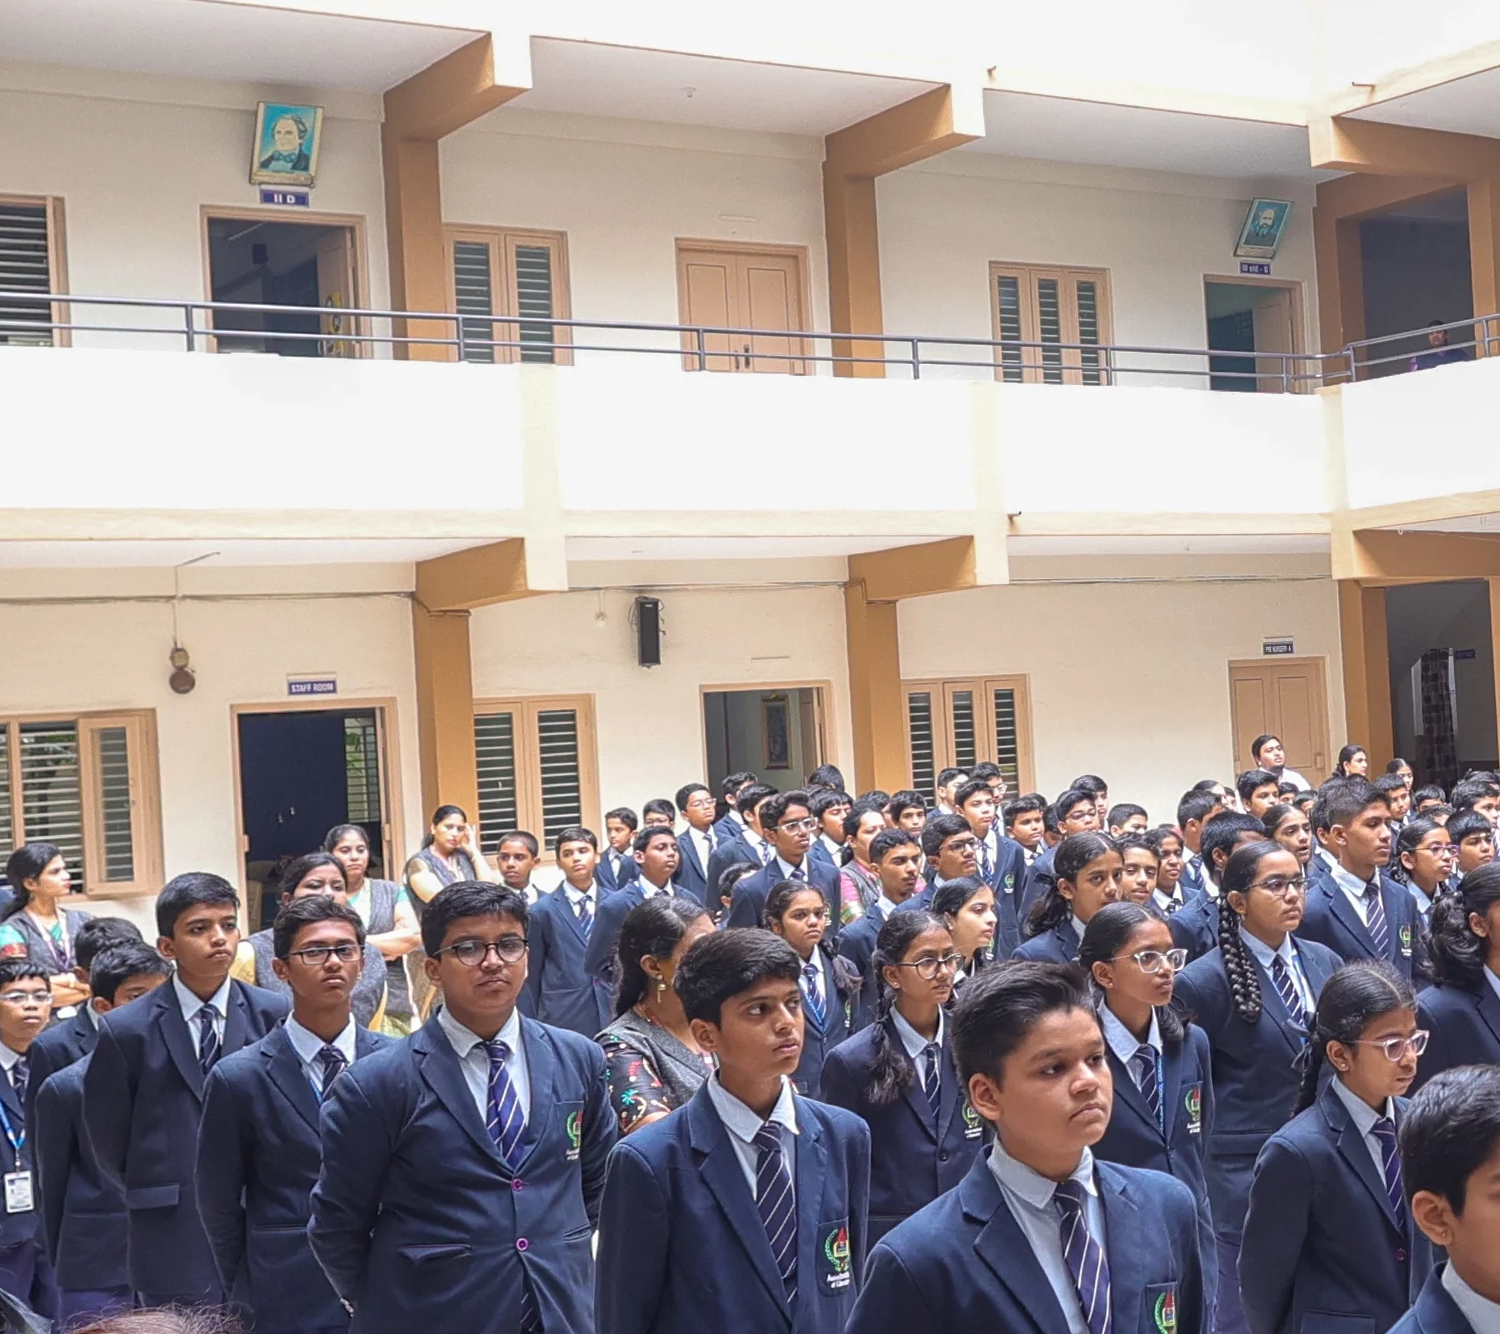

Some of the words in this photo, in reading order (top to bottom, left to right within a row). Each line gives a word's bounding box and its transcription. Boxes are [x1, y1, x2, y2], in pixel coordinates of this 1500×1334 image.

[273, 193, 283, 203] II
[286, 194, 295, 204] D
[291, 683, 311, 693] STAFF
[312, 682, 334, 692] ROOM
